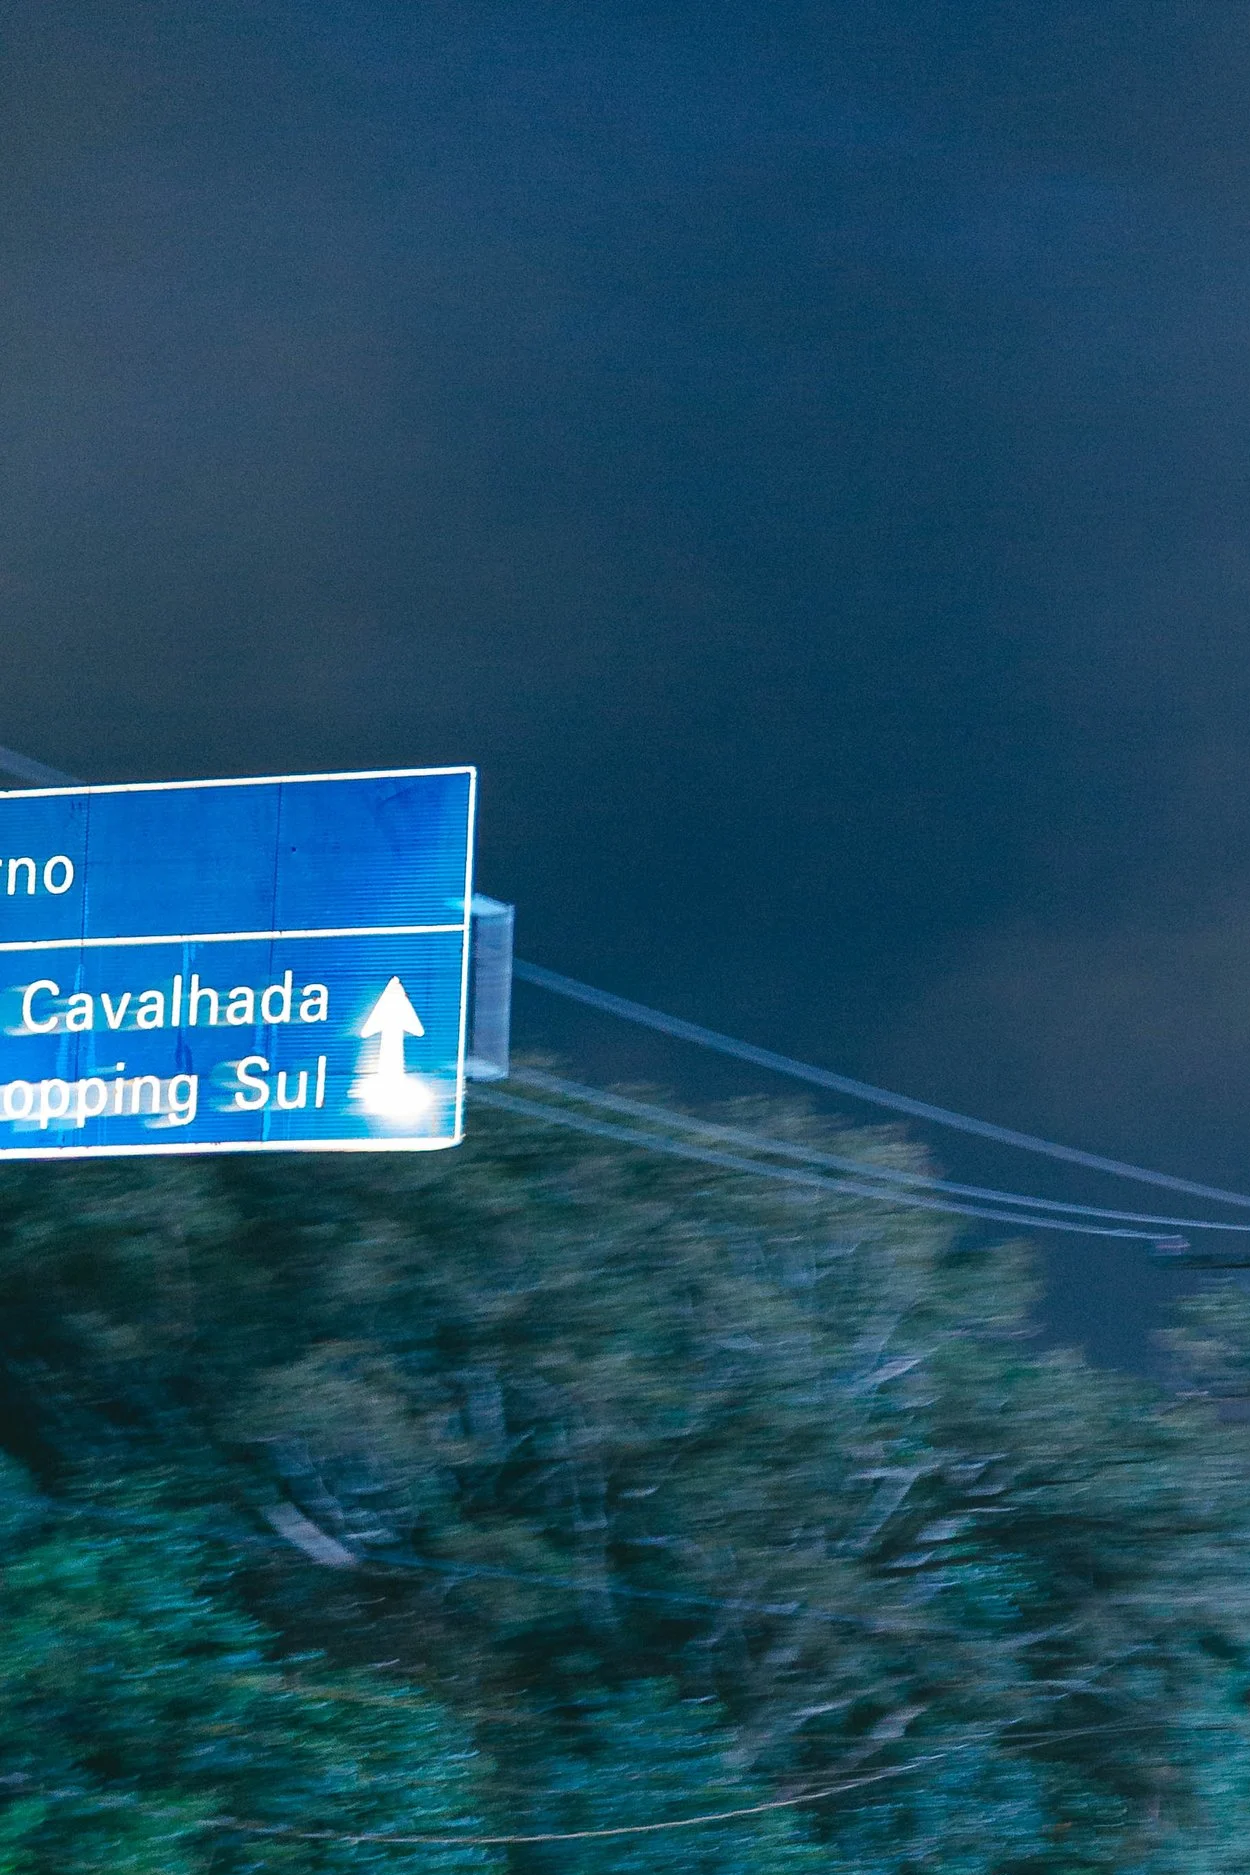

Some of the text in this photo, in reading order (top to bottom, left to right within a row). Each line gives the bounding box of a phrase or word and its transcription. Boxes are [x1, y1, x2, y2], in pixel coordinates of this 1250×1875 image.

[0, 855, 74, 895] no
[22, 970, 328, 1034] Cavalhada
[3, 1056, 327, 1130] opping Sul
